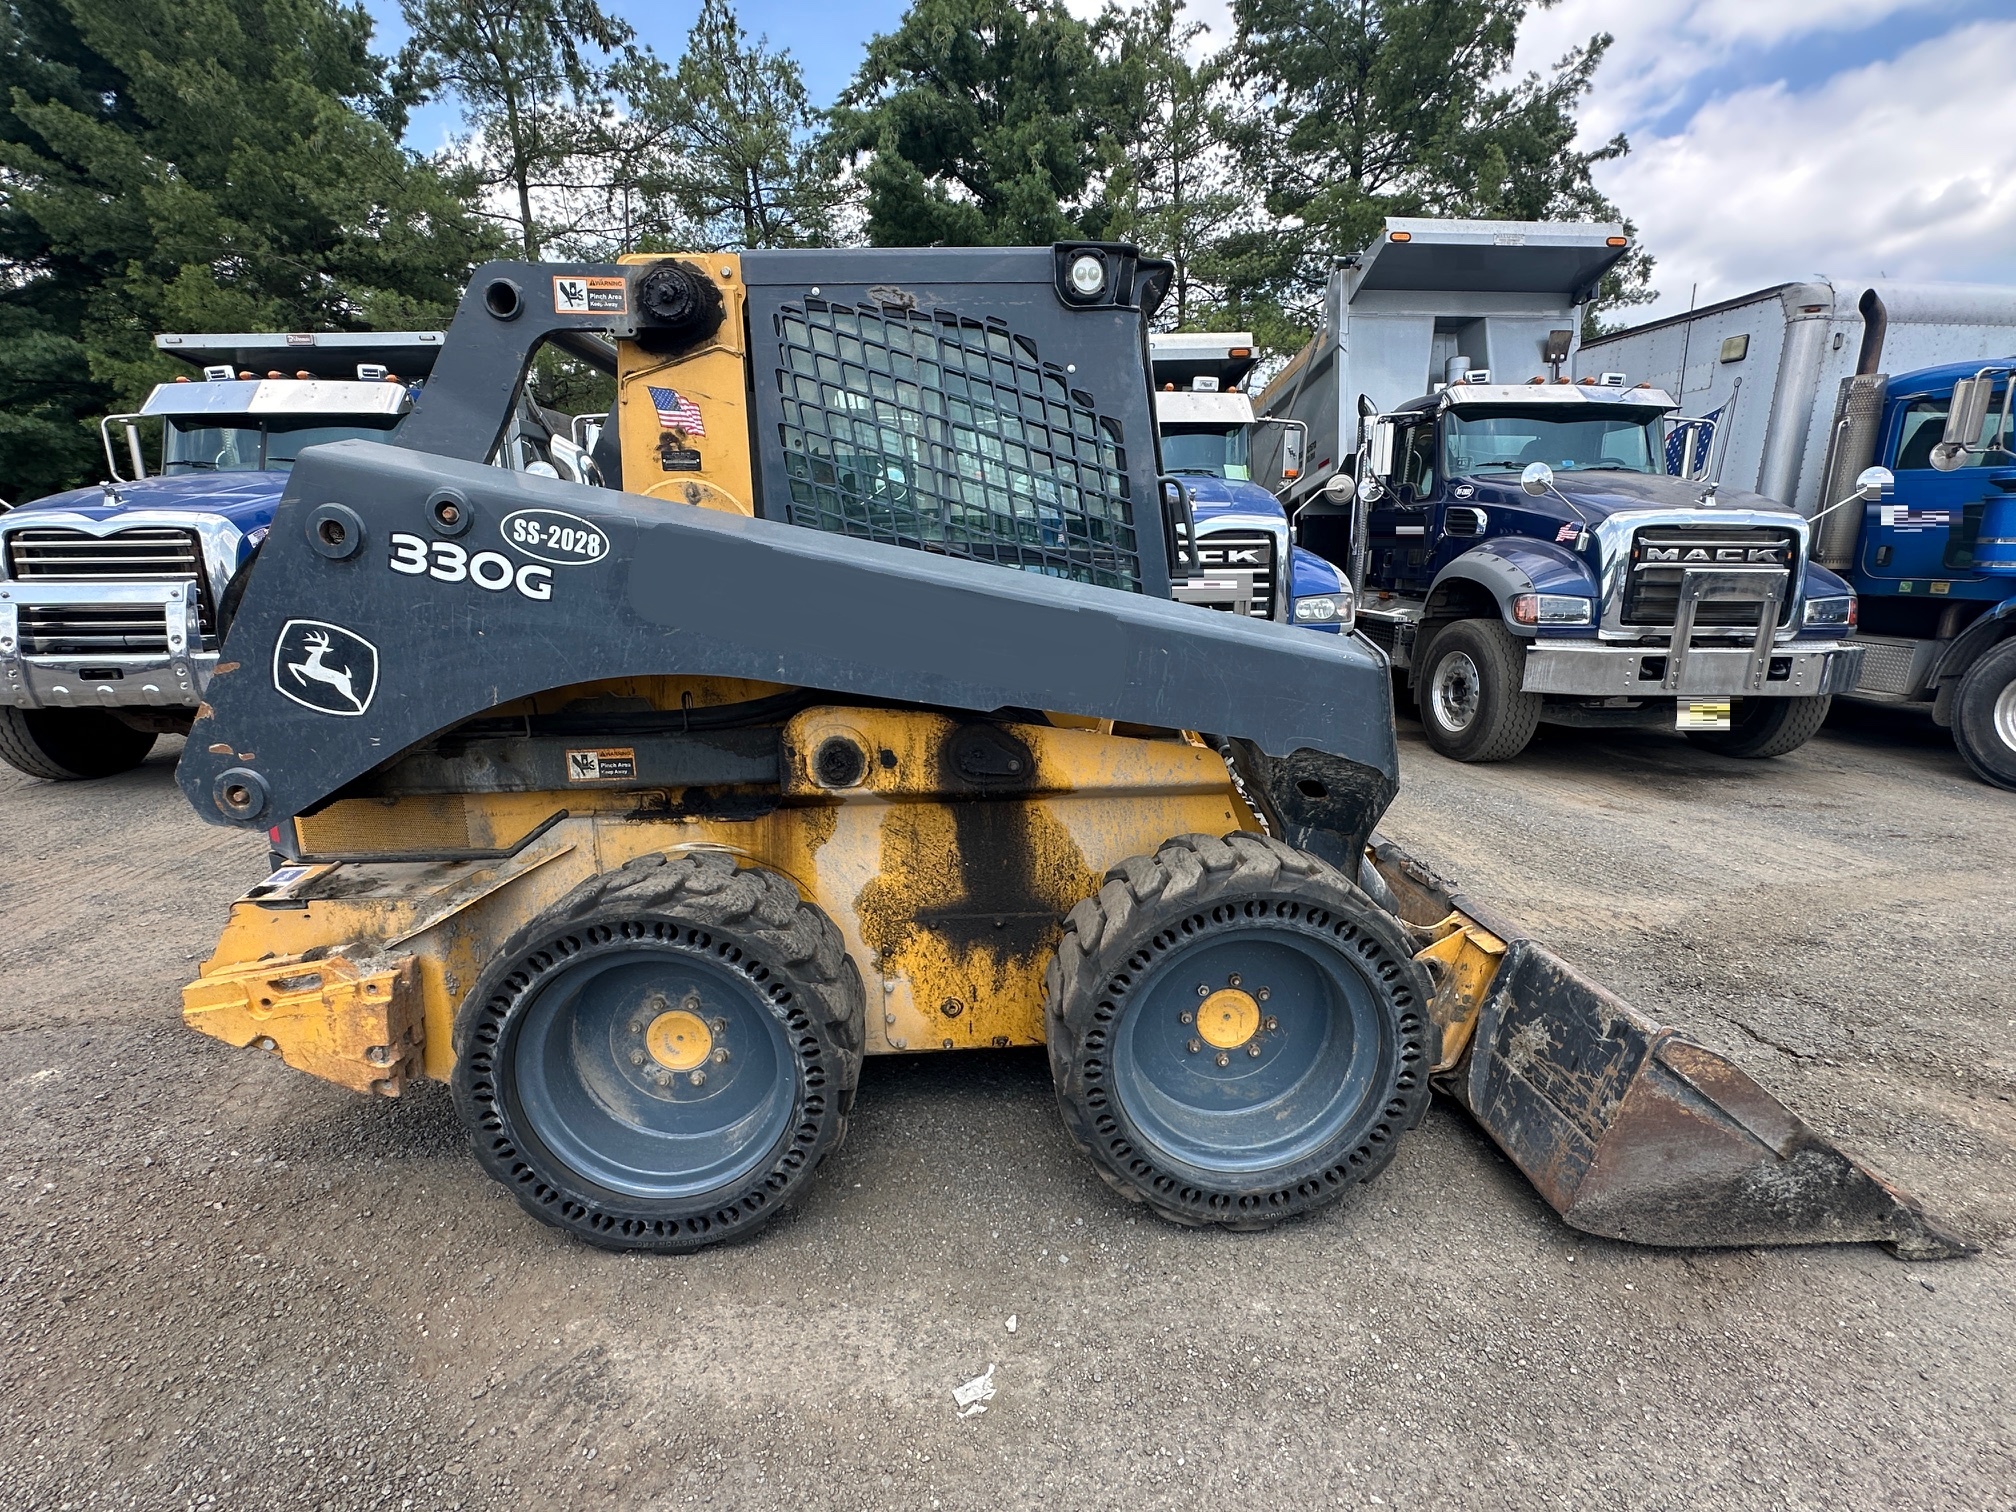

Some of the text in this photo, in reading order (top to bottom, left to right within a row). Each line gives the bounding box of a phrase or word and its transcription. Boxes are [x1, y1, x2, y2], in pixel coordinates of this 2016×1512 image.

[595, 279, 623, 287] WARNING
[513, 518, 600, 557] SS-2028
[389, 533, 552, 600] 330G
[1646, 547, 1780, 562] MACK
